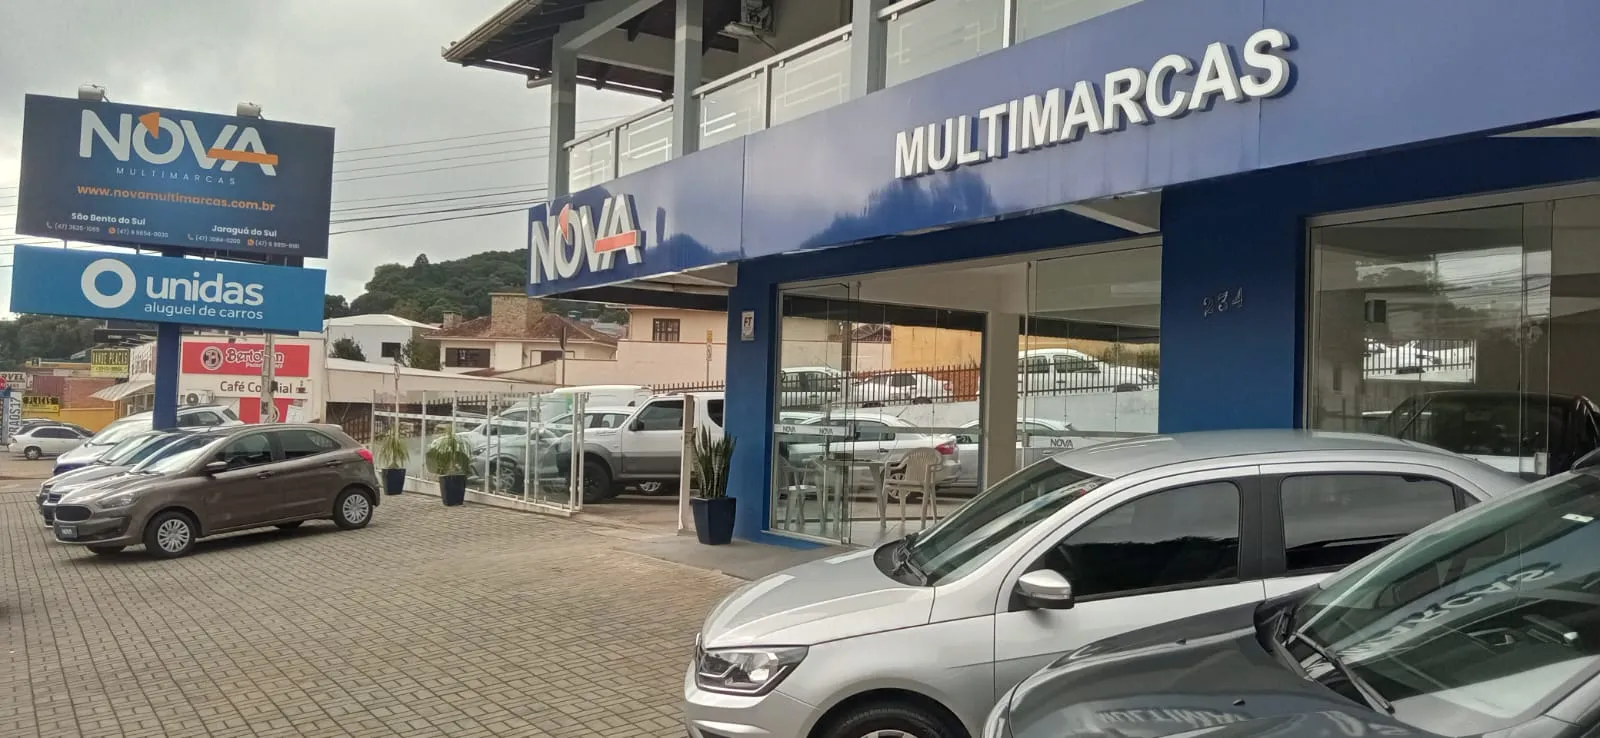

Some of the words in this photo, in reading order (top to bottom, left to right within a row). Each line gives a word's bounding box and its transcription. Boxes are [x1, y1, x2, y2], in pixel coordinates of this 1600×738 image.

[894, 28, 1292, 178] MULTIMARCAS
[79, 109, 278, 176] NOVA
[116, 167, 236, 185] MULTIMARCAS
[77, 184, 275, 211] www.novamultimarcas.com.br
[71, 212, 88, 221] São
[90, 213, 116, 223] Bento
[118, 215, 130, 224] do
[131, 216, 146, 225] Sul
[211, 224, 249, 236] Jaraguá
[250, 227, 262, 236] do
[263, 228, 278, 237] Sul
[530, 193, 642, 285] NOVA
[146, 271, 265, 306] unidas
[144, 301, 196, 316] aluguel
[198, 304, 216, 317] de
[219, 307, 264, 320] carros
[1203, 287, 1243, 317] 234
[220, 380, 245, 392] Café
[247, 381, 292, 394] Coial
[1050, 438, 1073, 449] NOVA
